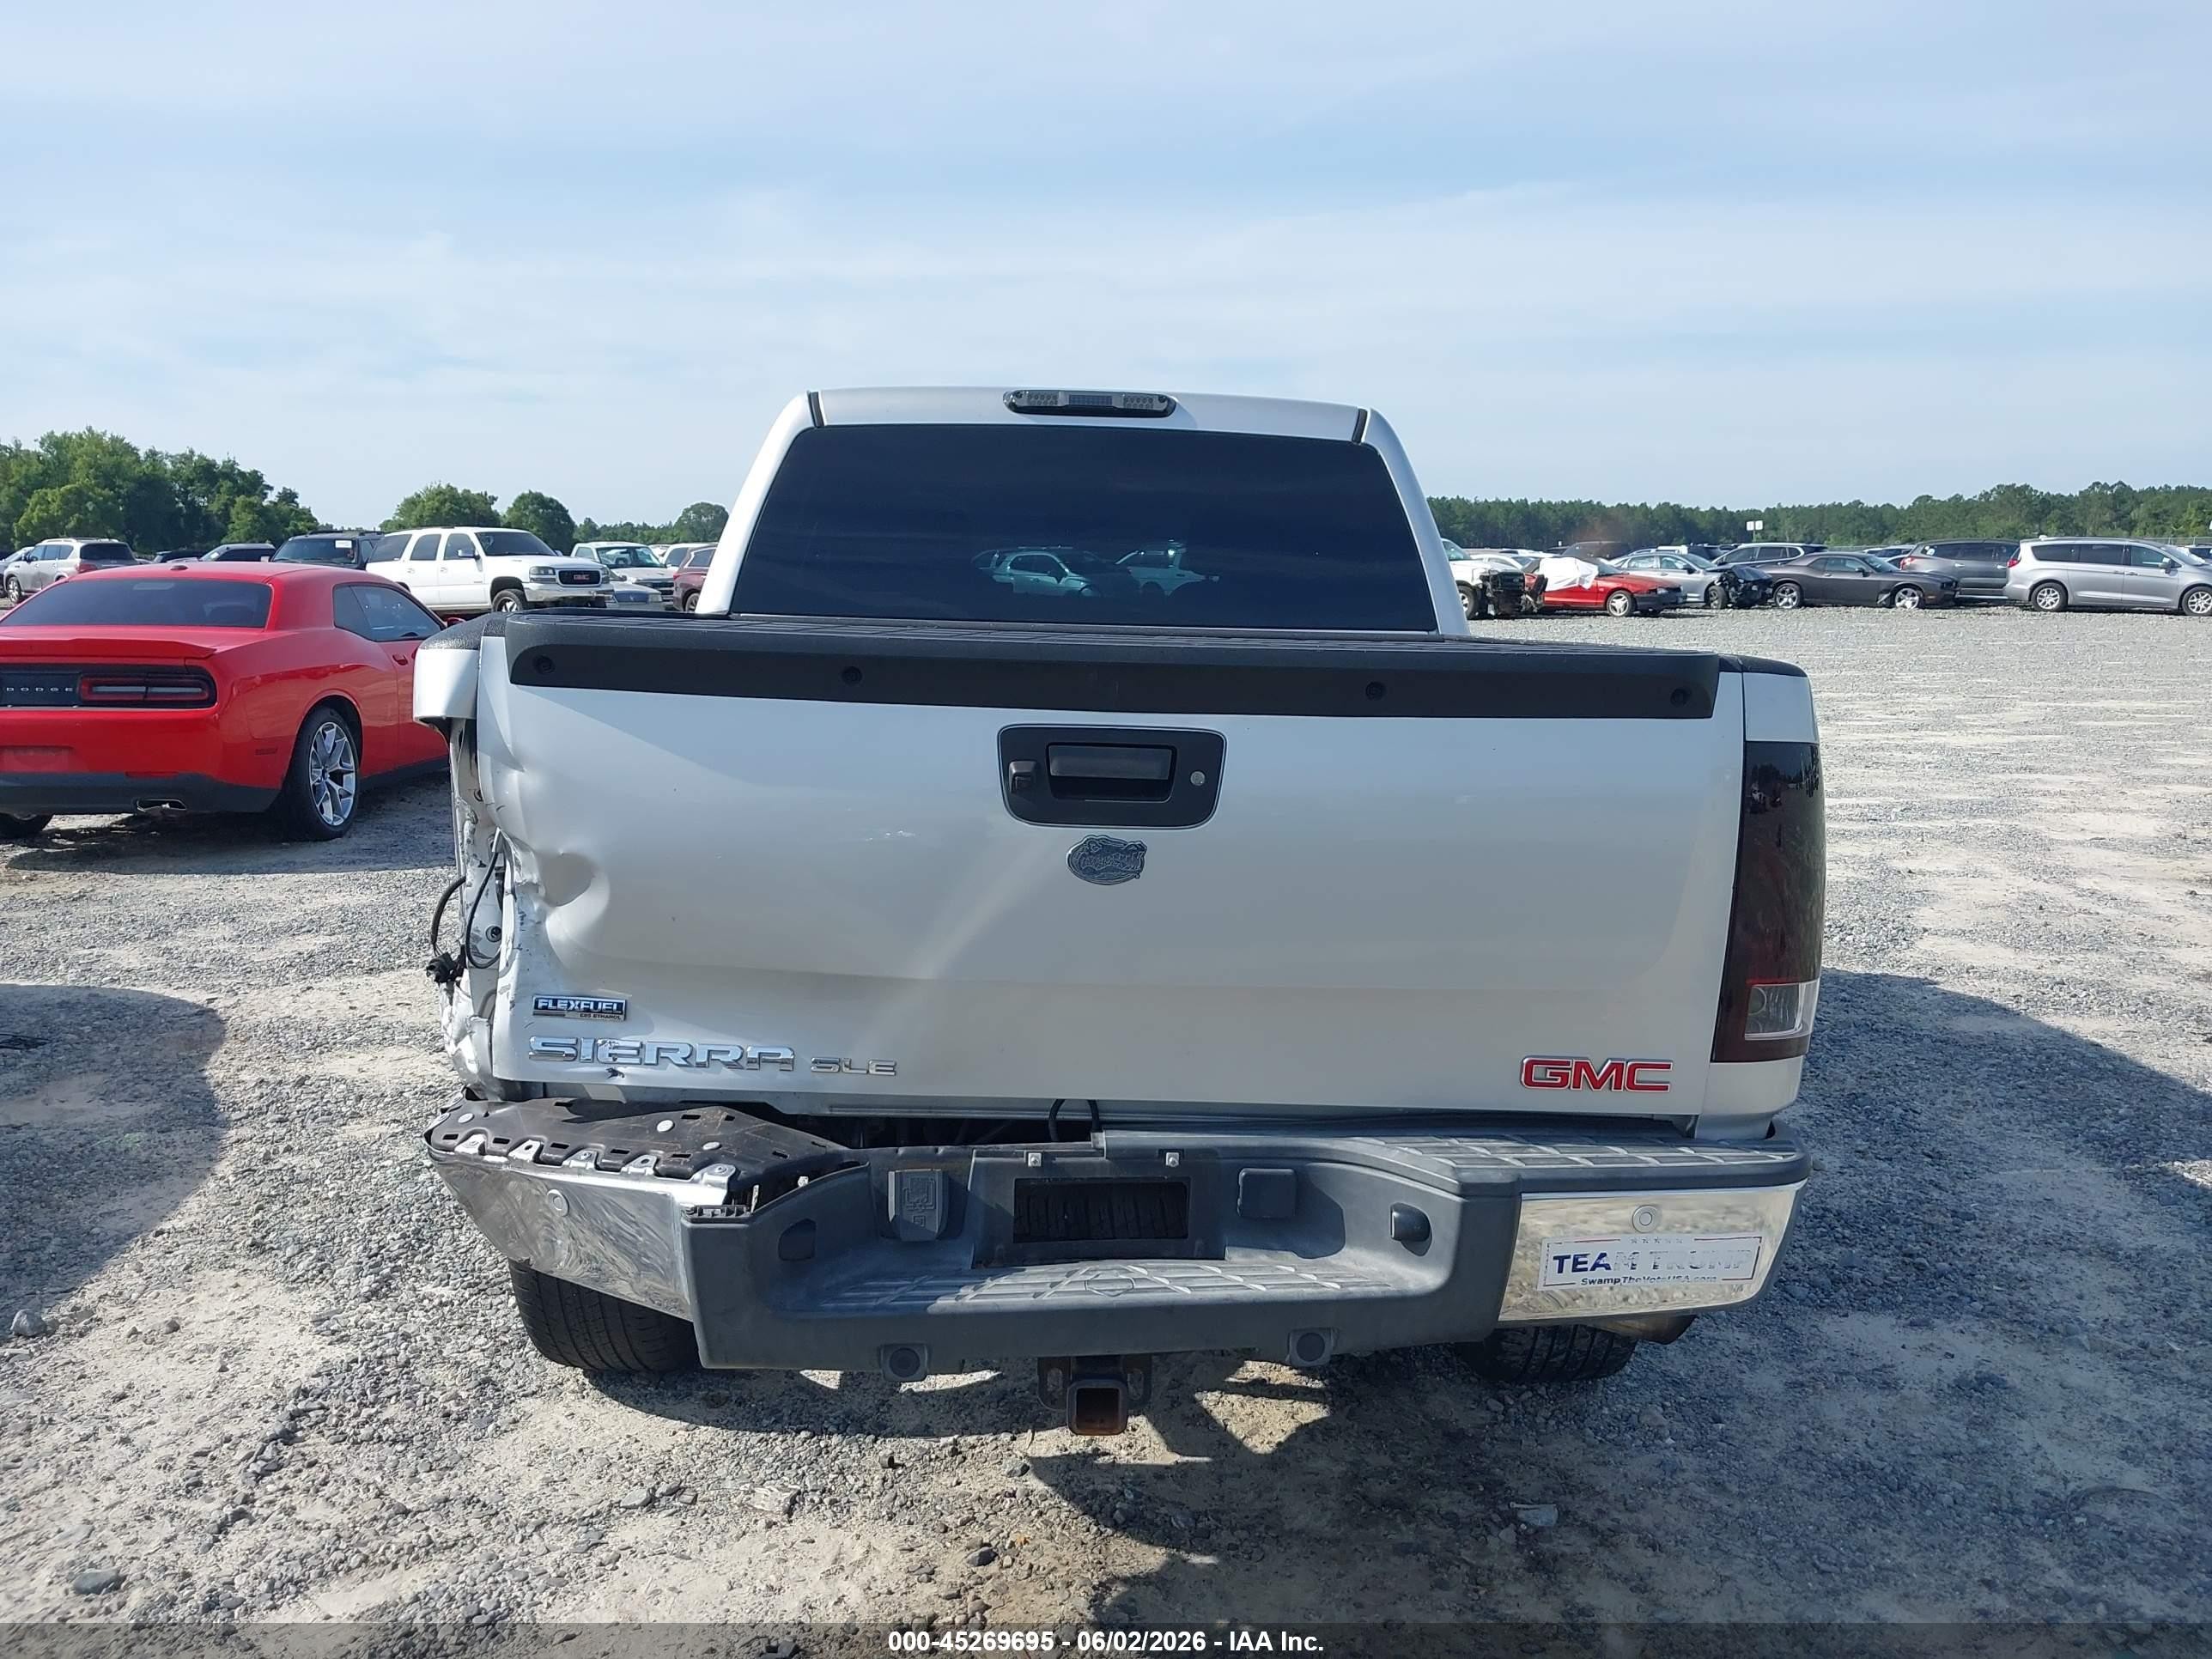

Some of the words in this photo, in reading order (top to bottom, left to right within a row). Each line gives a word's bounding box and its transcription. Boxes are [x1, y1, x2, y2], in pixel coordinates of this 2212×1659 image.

[537, 998, 623, 1014] FLEXFUEL
[528, 1036, 796, 1072] SIERRA
[810, 1056, 898, 1077] SLE
[1520, 1056, 1674, 1092] GMC
